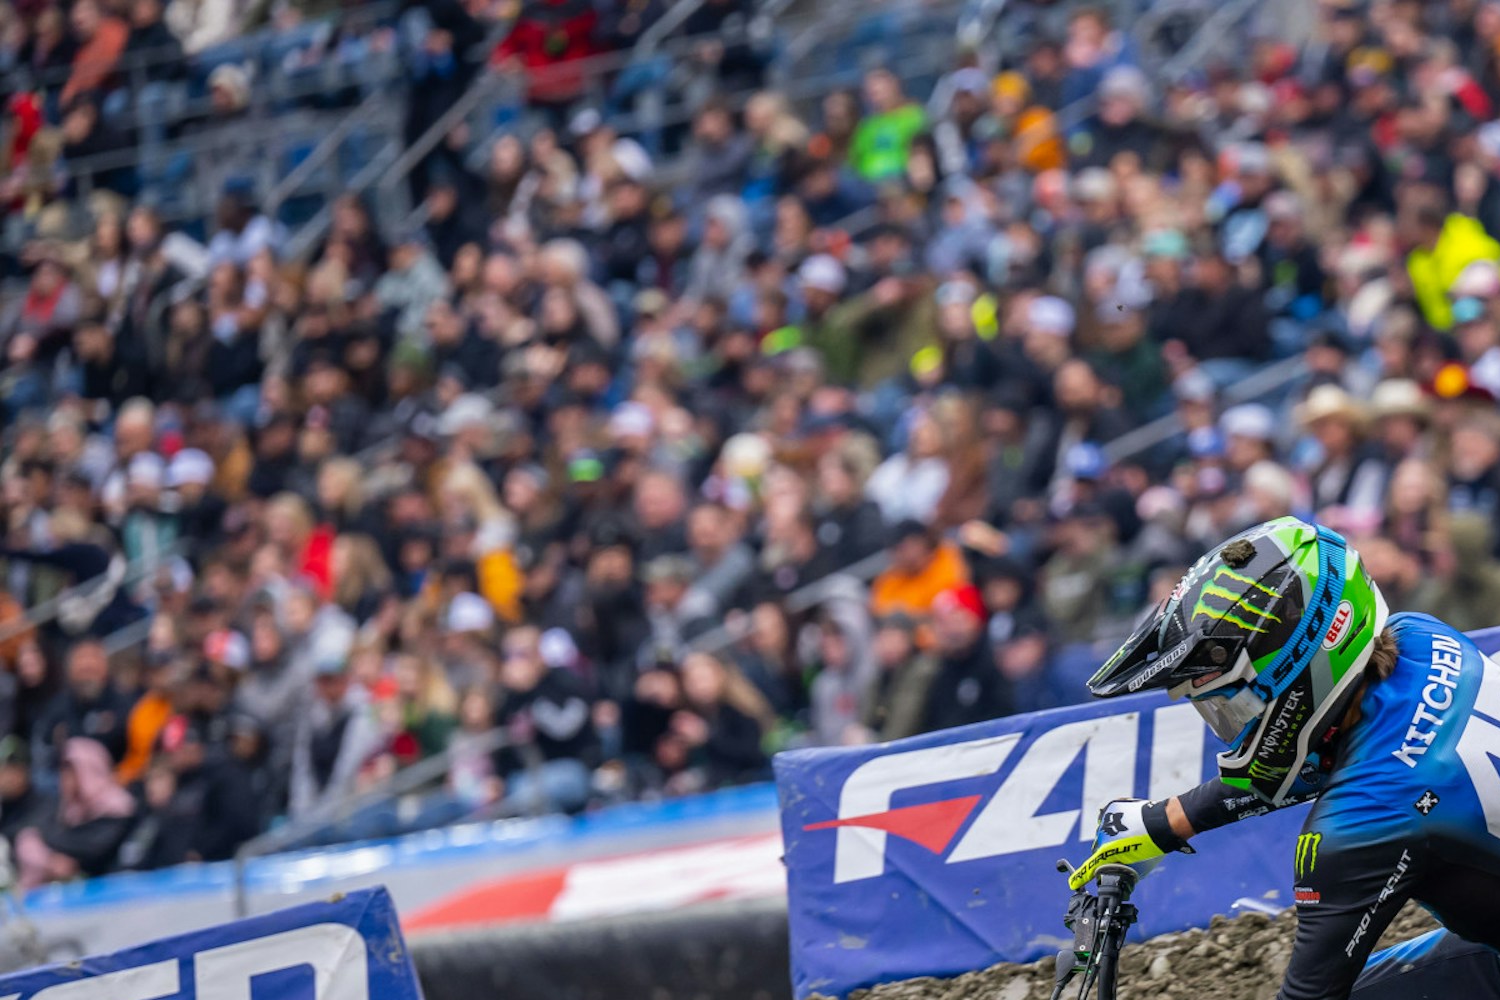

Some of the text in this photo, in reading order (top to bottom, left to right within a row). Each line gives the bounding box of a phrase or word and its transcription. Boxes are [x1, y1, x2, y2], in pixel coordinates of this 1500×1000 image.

[1272, 555, 1341, 686] SCOTT
[1325, 607, 1350, 644] BELL
[1257, 690, 1305, 760] MONSTER
[1391, 633, 1462, 768] KITCHEN
[1278, 704, 1308, 754] ENERGY
[1070, 842, 1143, 886] PRO CIRCUIT
[1345, 912, 1372, 958] PRO
